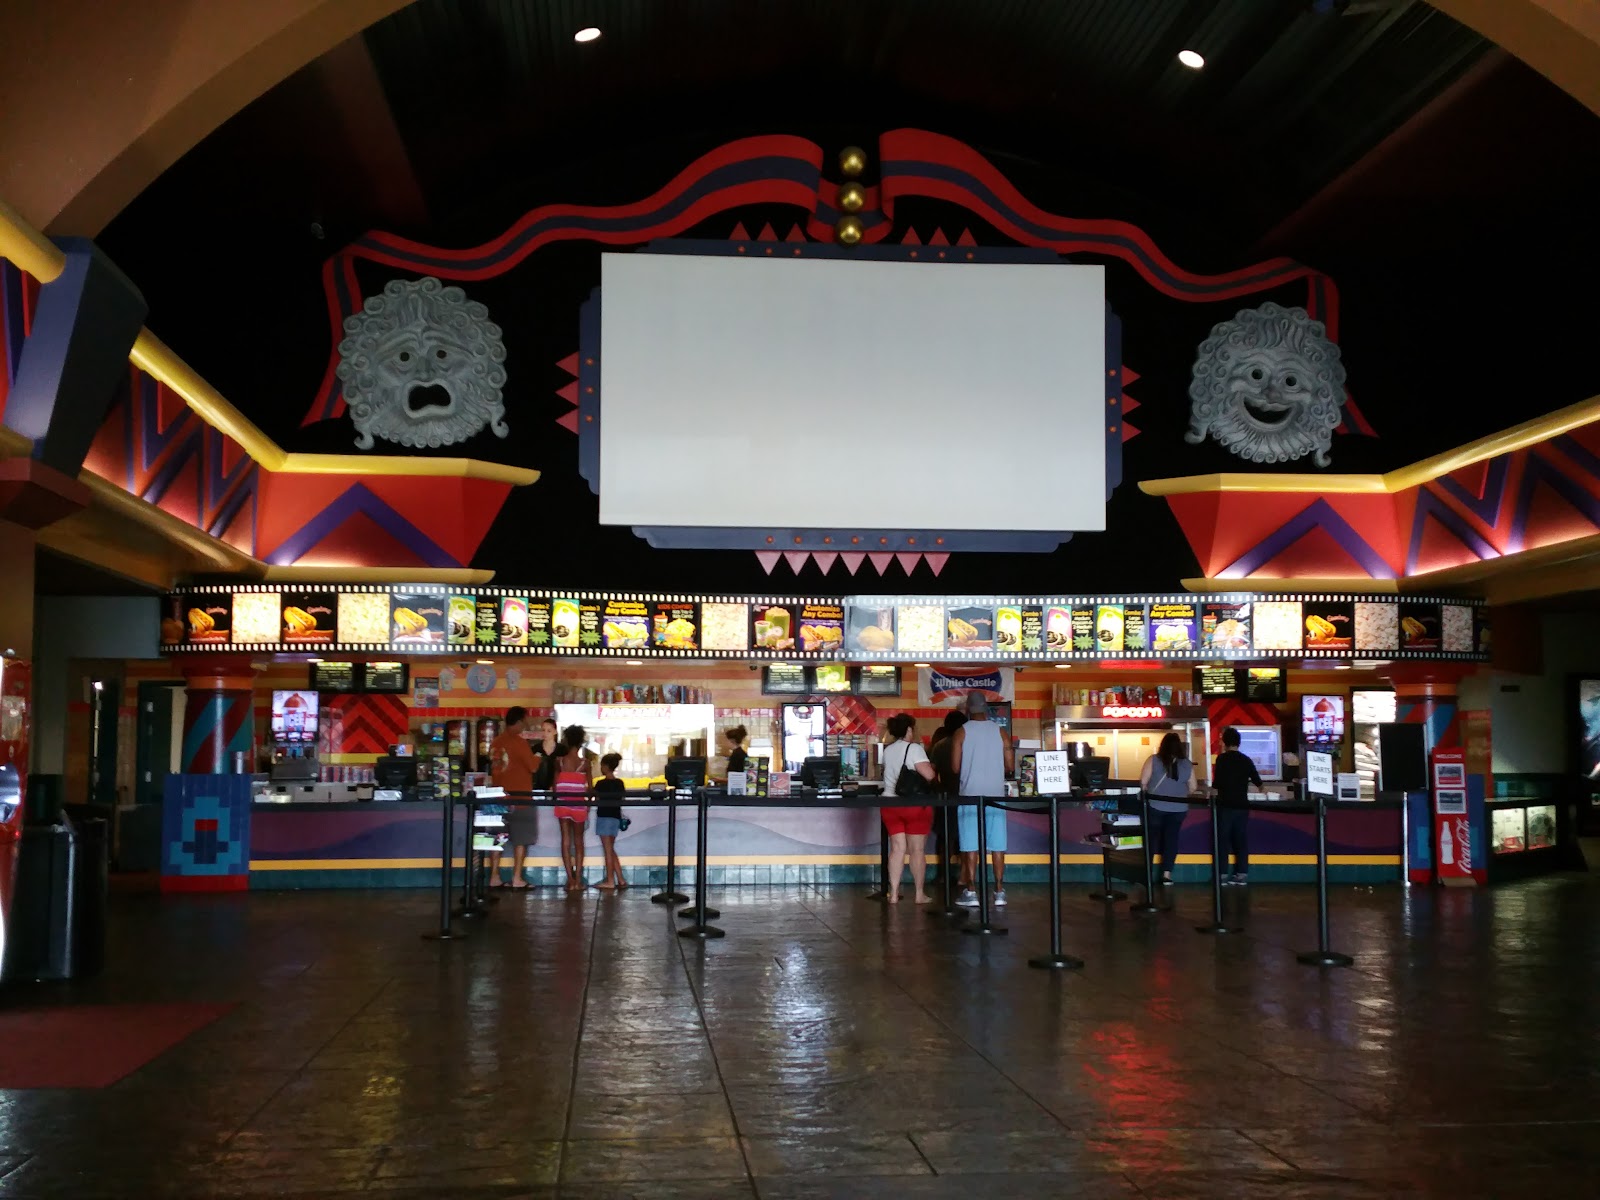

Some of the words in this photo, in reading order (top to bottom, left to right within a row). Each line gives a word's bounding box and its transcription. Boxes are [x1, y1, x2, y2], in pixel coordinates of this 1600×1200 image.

[935, 677, 964, 688] White
[965, 677, 997, 688] Castle
[1312, 755, 1326, 763] LINE
[1038, 765, 1066, 773] STARTS
[1308, 765, 1331, 774] STARTS
[1312, 776, 1328, 784] HERE
